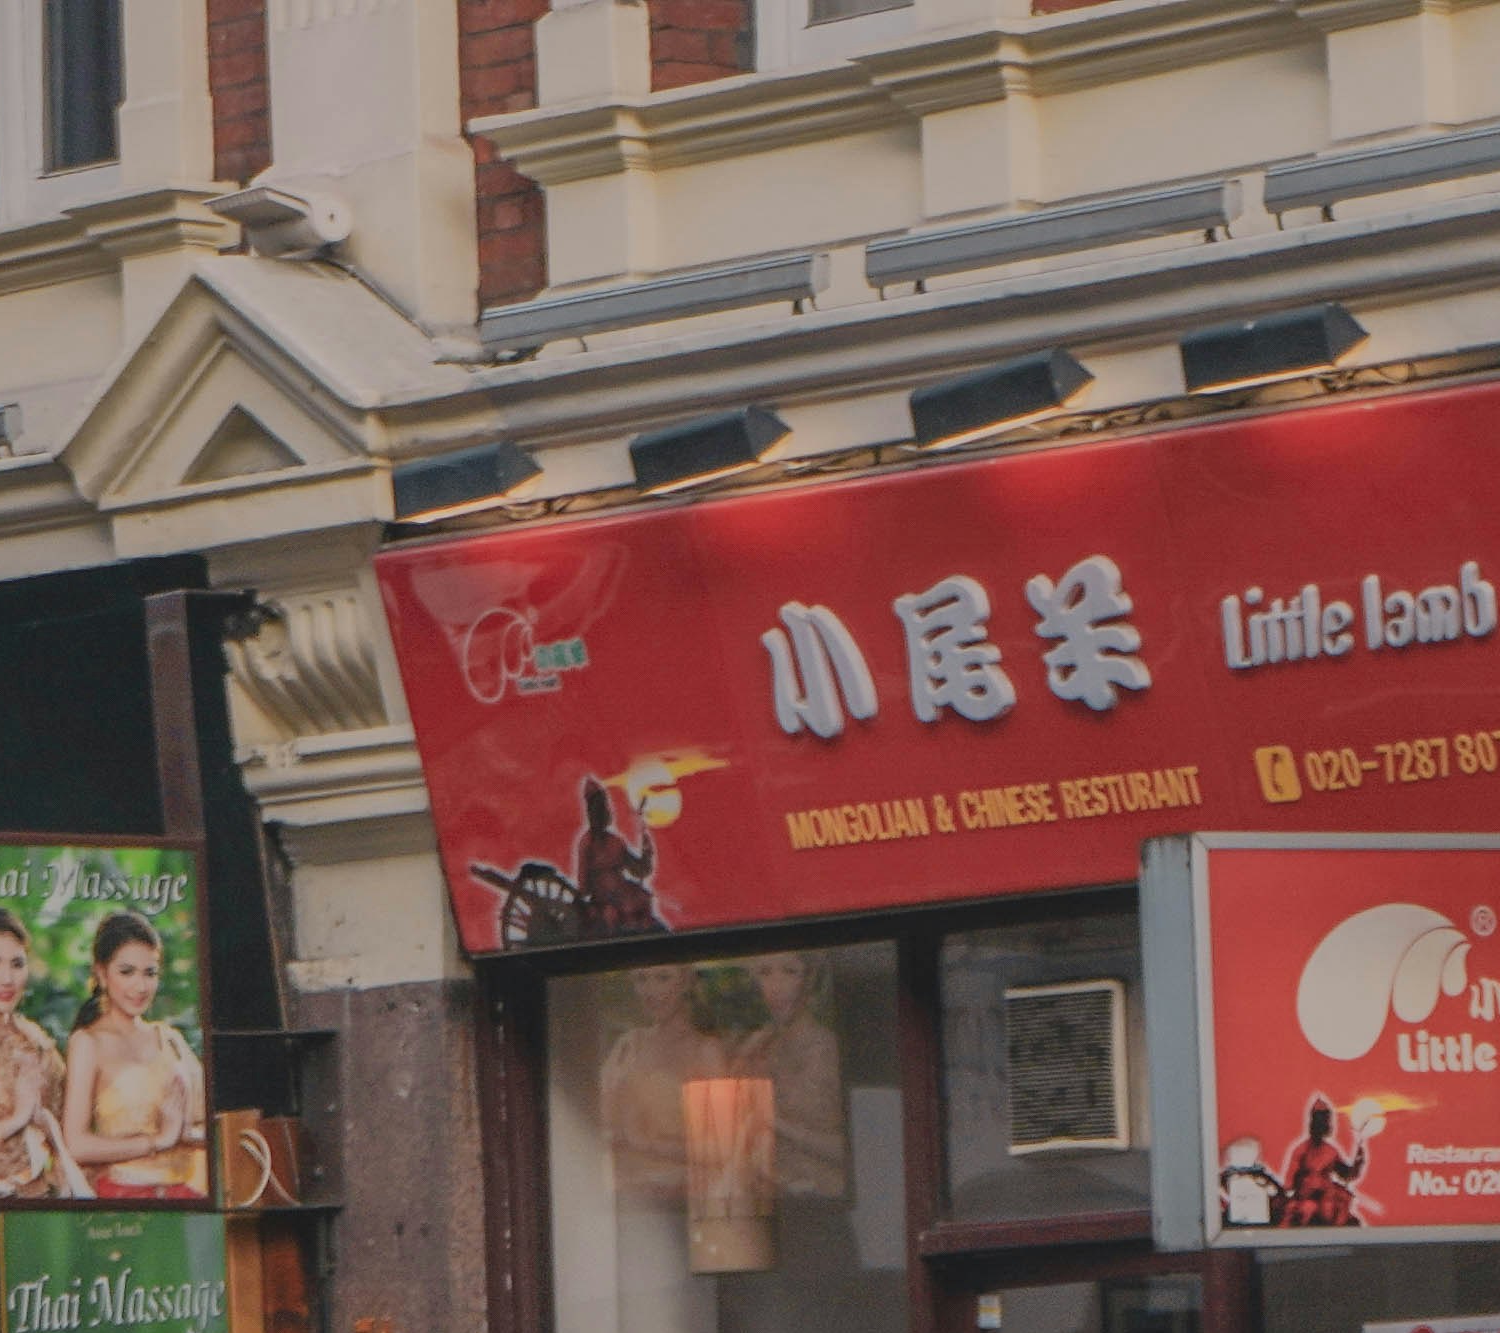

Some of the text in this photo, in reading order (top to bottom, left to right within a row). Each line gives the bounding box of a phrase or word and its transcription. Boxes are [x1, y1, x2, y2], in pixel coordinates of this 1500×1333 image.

[1220, 561, 1498, 670] Little lamb
[1305, 737, 1449, 791] 020-7287
[786, 766, 1202, 850] MONGOLIAN & CHINESE RESTURANT
[40, 860, 188, 916] Massage
[1397, 1031, 1497, 1073] Little
[8, 1274, 82, 1333] Thai
